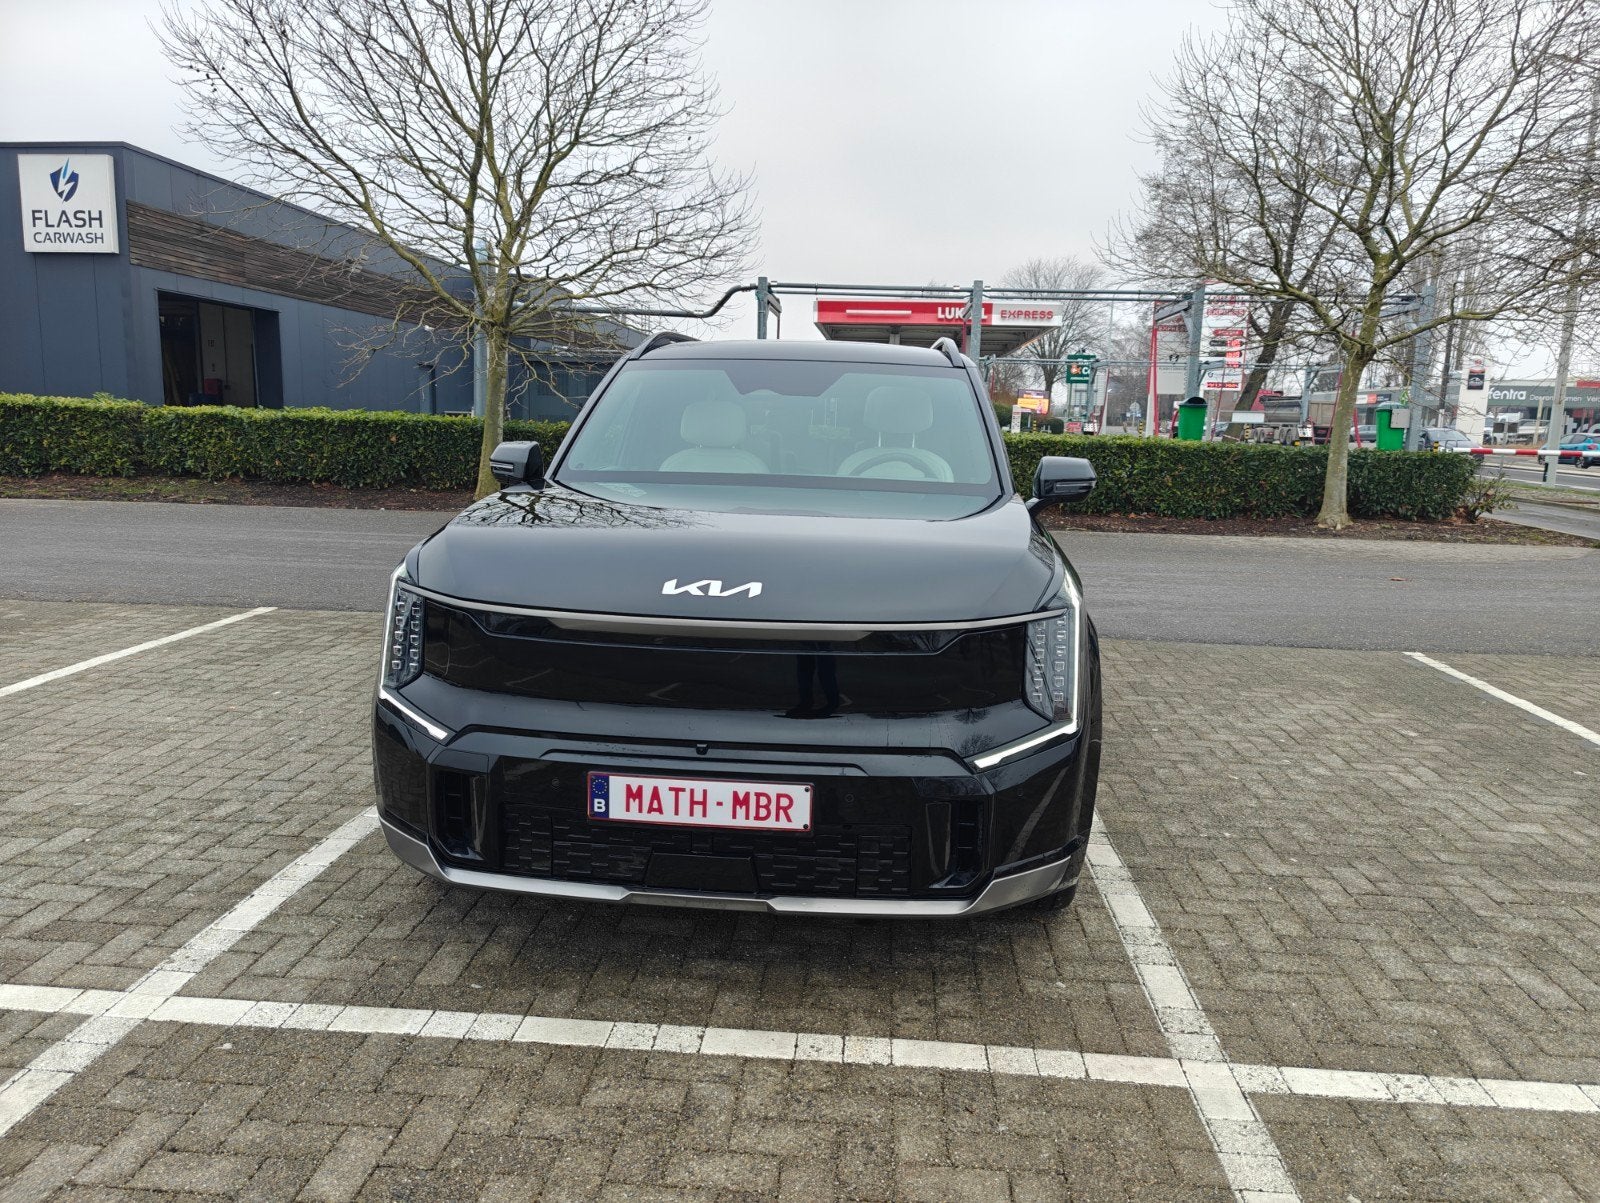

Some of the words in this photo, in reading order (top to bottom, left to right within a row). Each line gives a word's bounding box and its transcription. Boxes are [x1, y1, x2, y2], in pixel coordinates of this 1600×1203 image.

[31, 209, 104, 229] FLASH
[33, 231, 105, 244] CARWASH
[937, 306, 989, 320] LUKL
[1000, 309, 1054, 320] EXPRESS
[661, 578, 763, 598] KIA
[593, 798, 606, 813] B
[625, 783, 795, 823] MATH-MBR
